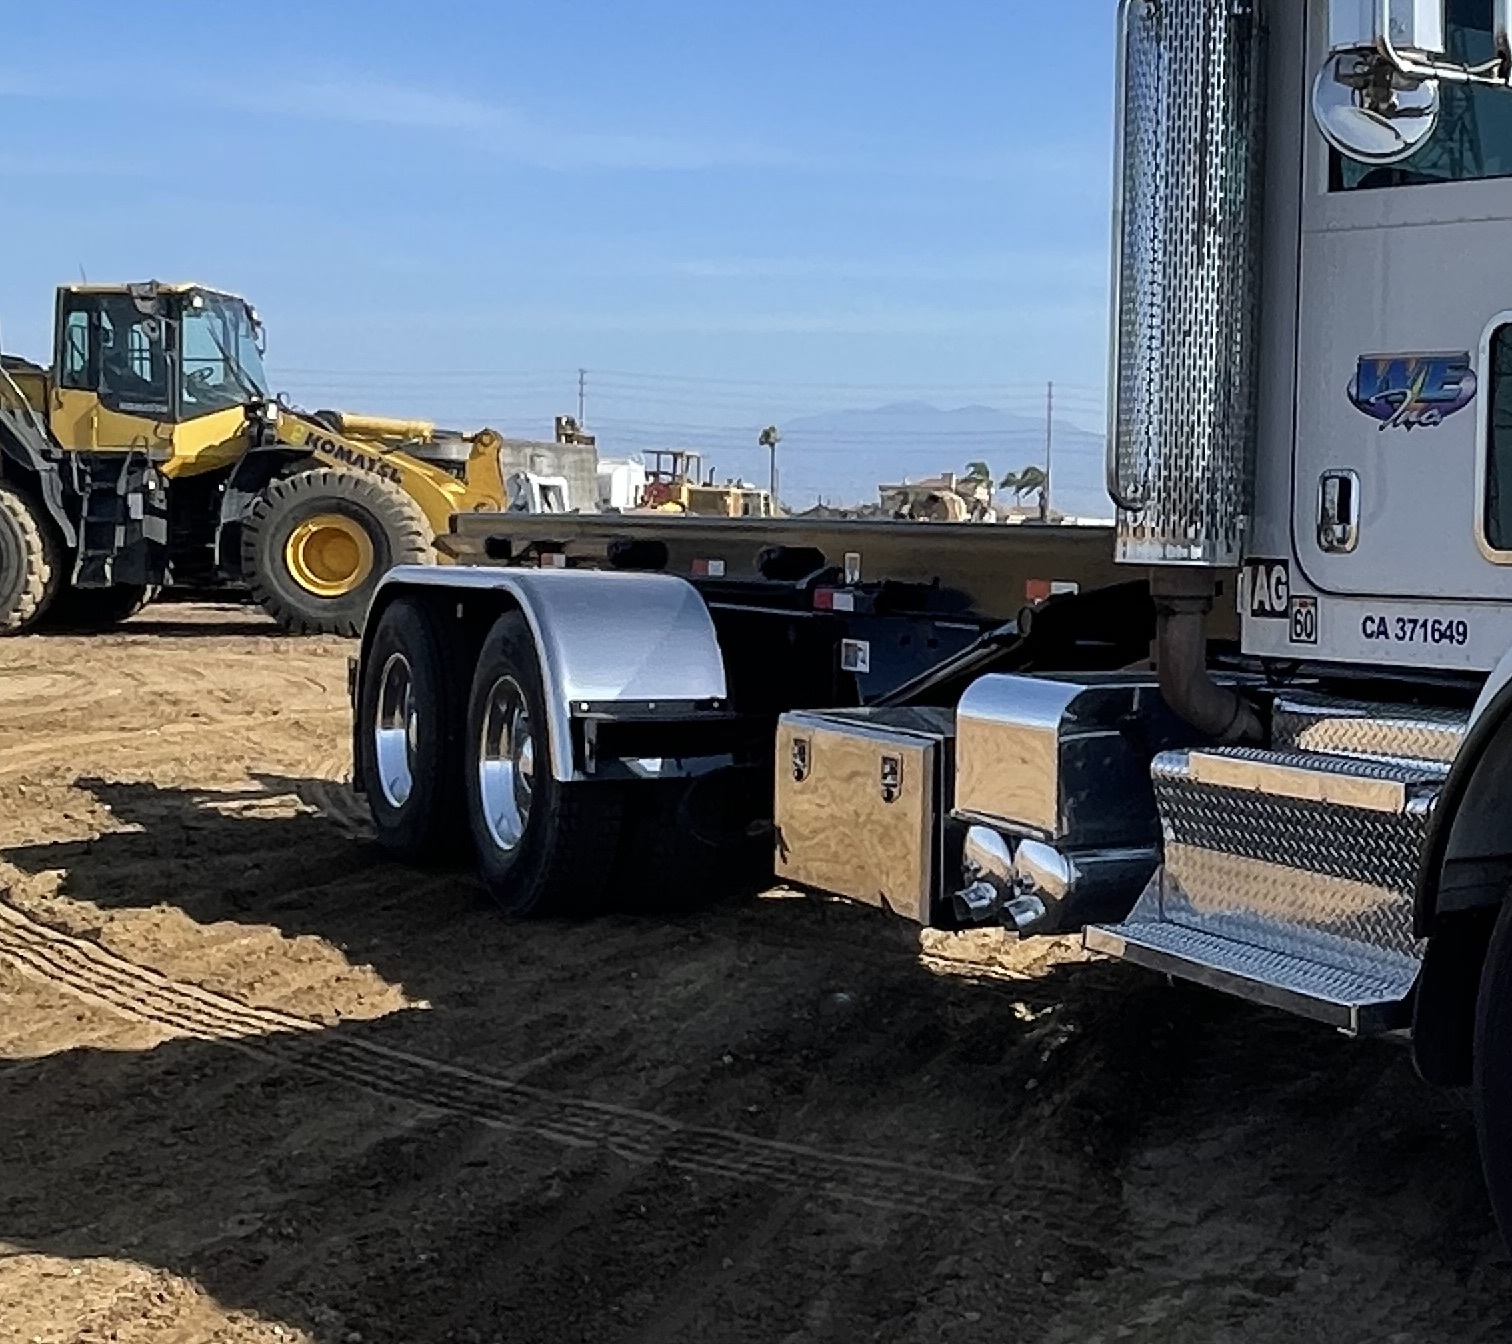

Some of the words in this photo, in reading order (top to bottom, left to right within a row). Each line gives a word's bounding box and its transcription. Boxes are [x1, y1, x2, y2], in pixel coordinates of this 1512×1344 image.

[1294, 608, 1314, 640] 60
[1361, 615, 1390, 640] CA
[1394, 617, 1468, 646] 371649
